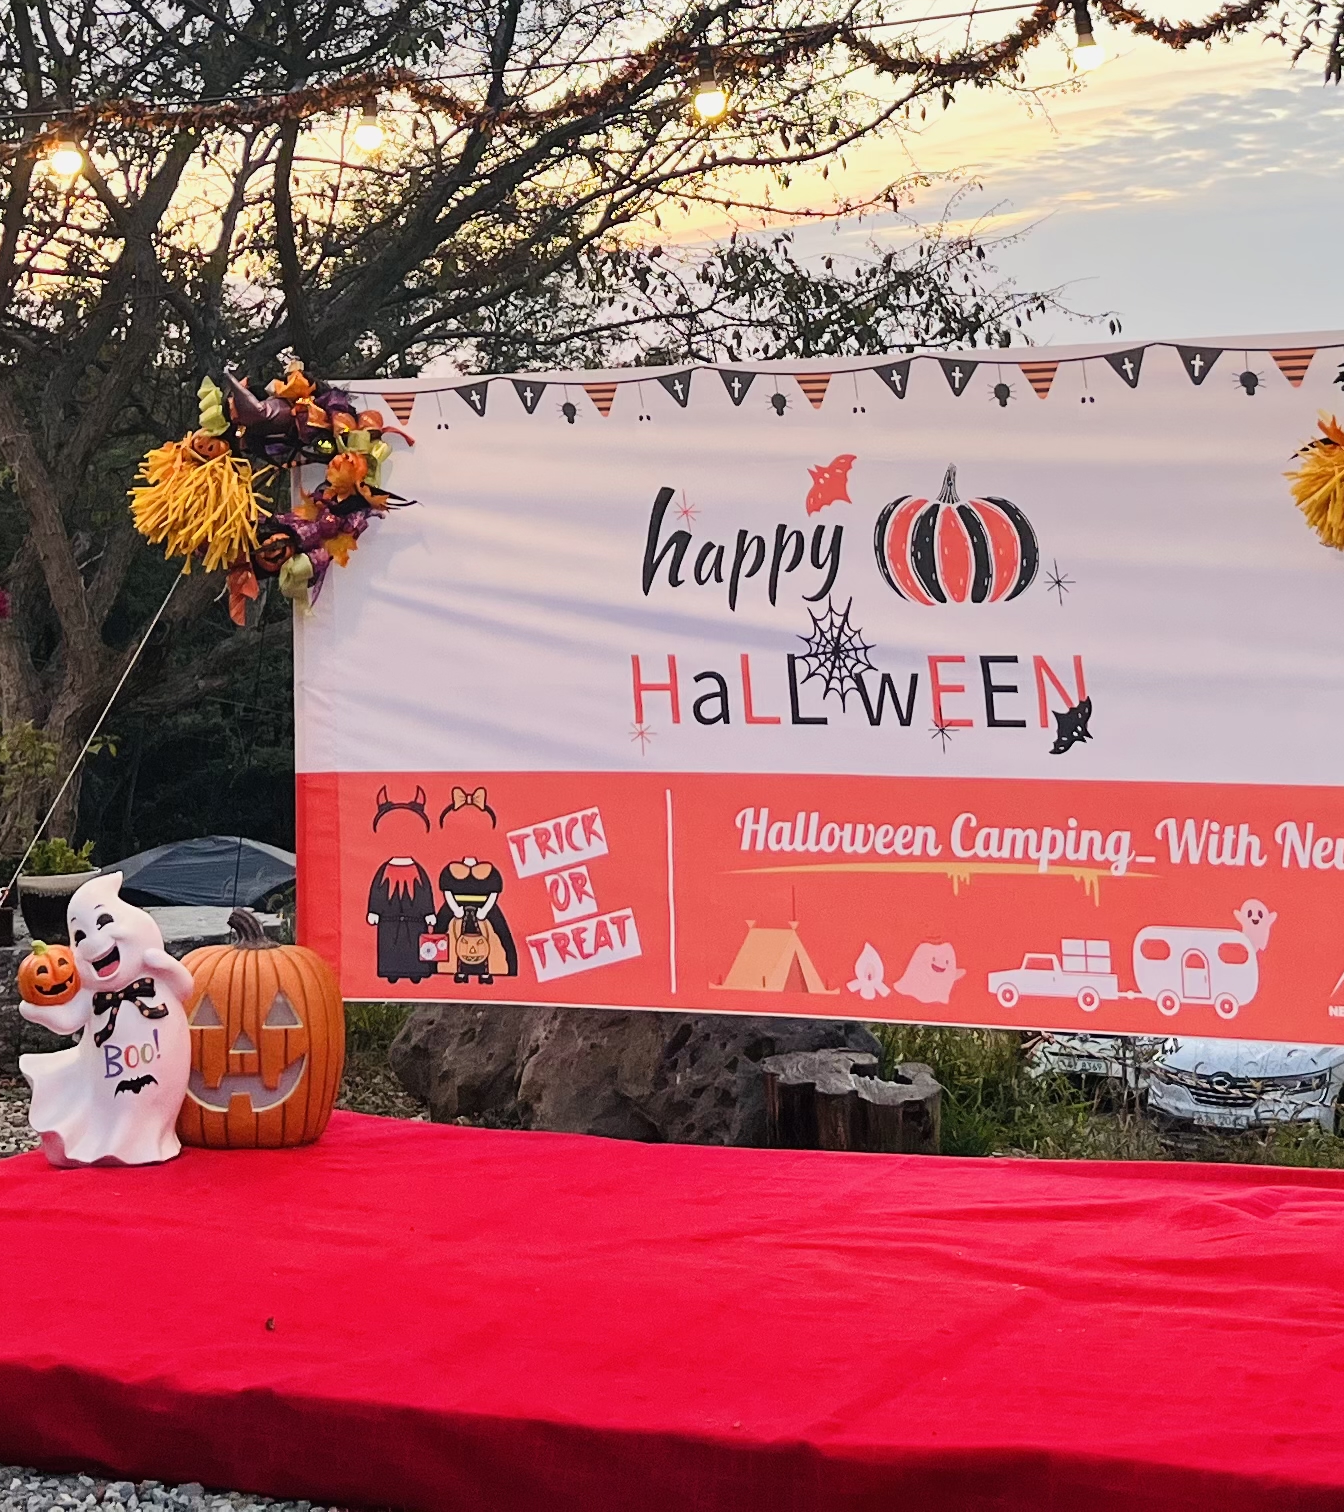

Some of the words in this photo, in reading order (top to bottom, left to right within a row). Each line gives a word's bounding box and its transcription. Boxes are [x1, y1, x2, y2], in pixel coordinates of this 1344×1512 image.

[641, 486, 844, 612] happy
[508, 811, 604, 867] TRICK
[734, 806, 943, 857] Halloween
[549, 871, 595, 913] OR
[527, 914, 633, 971] TREAT
